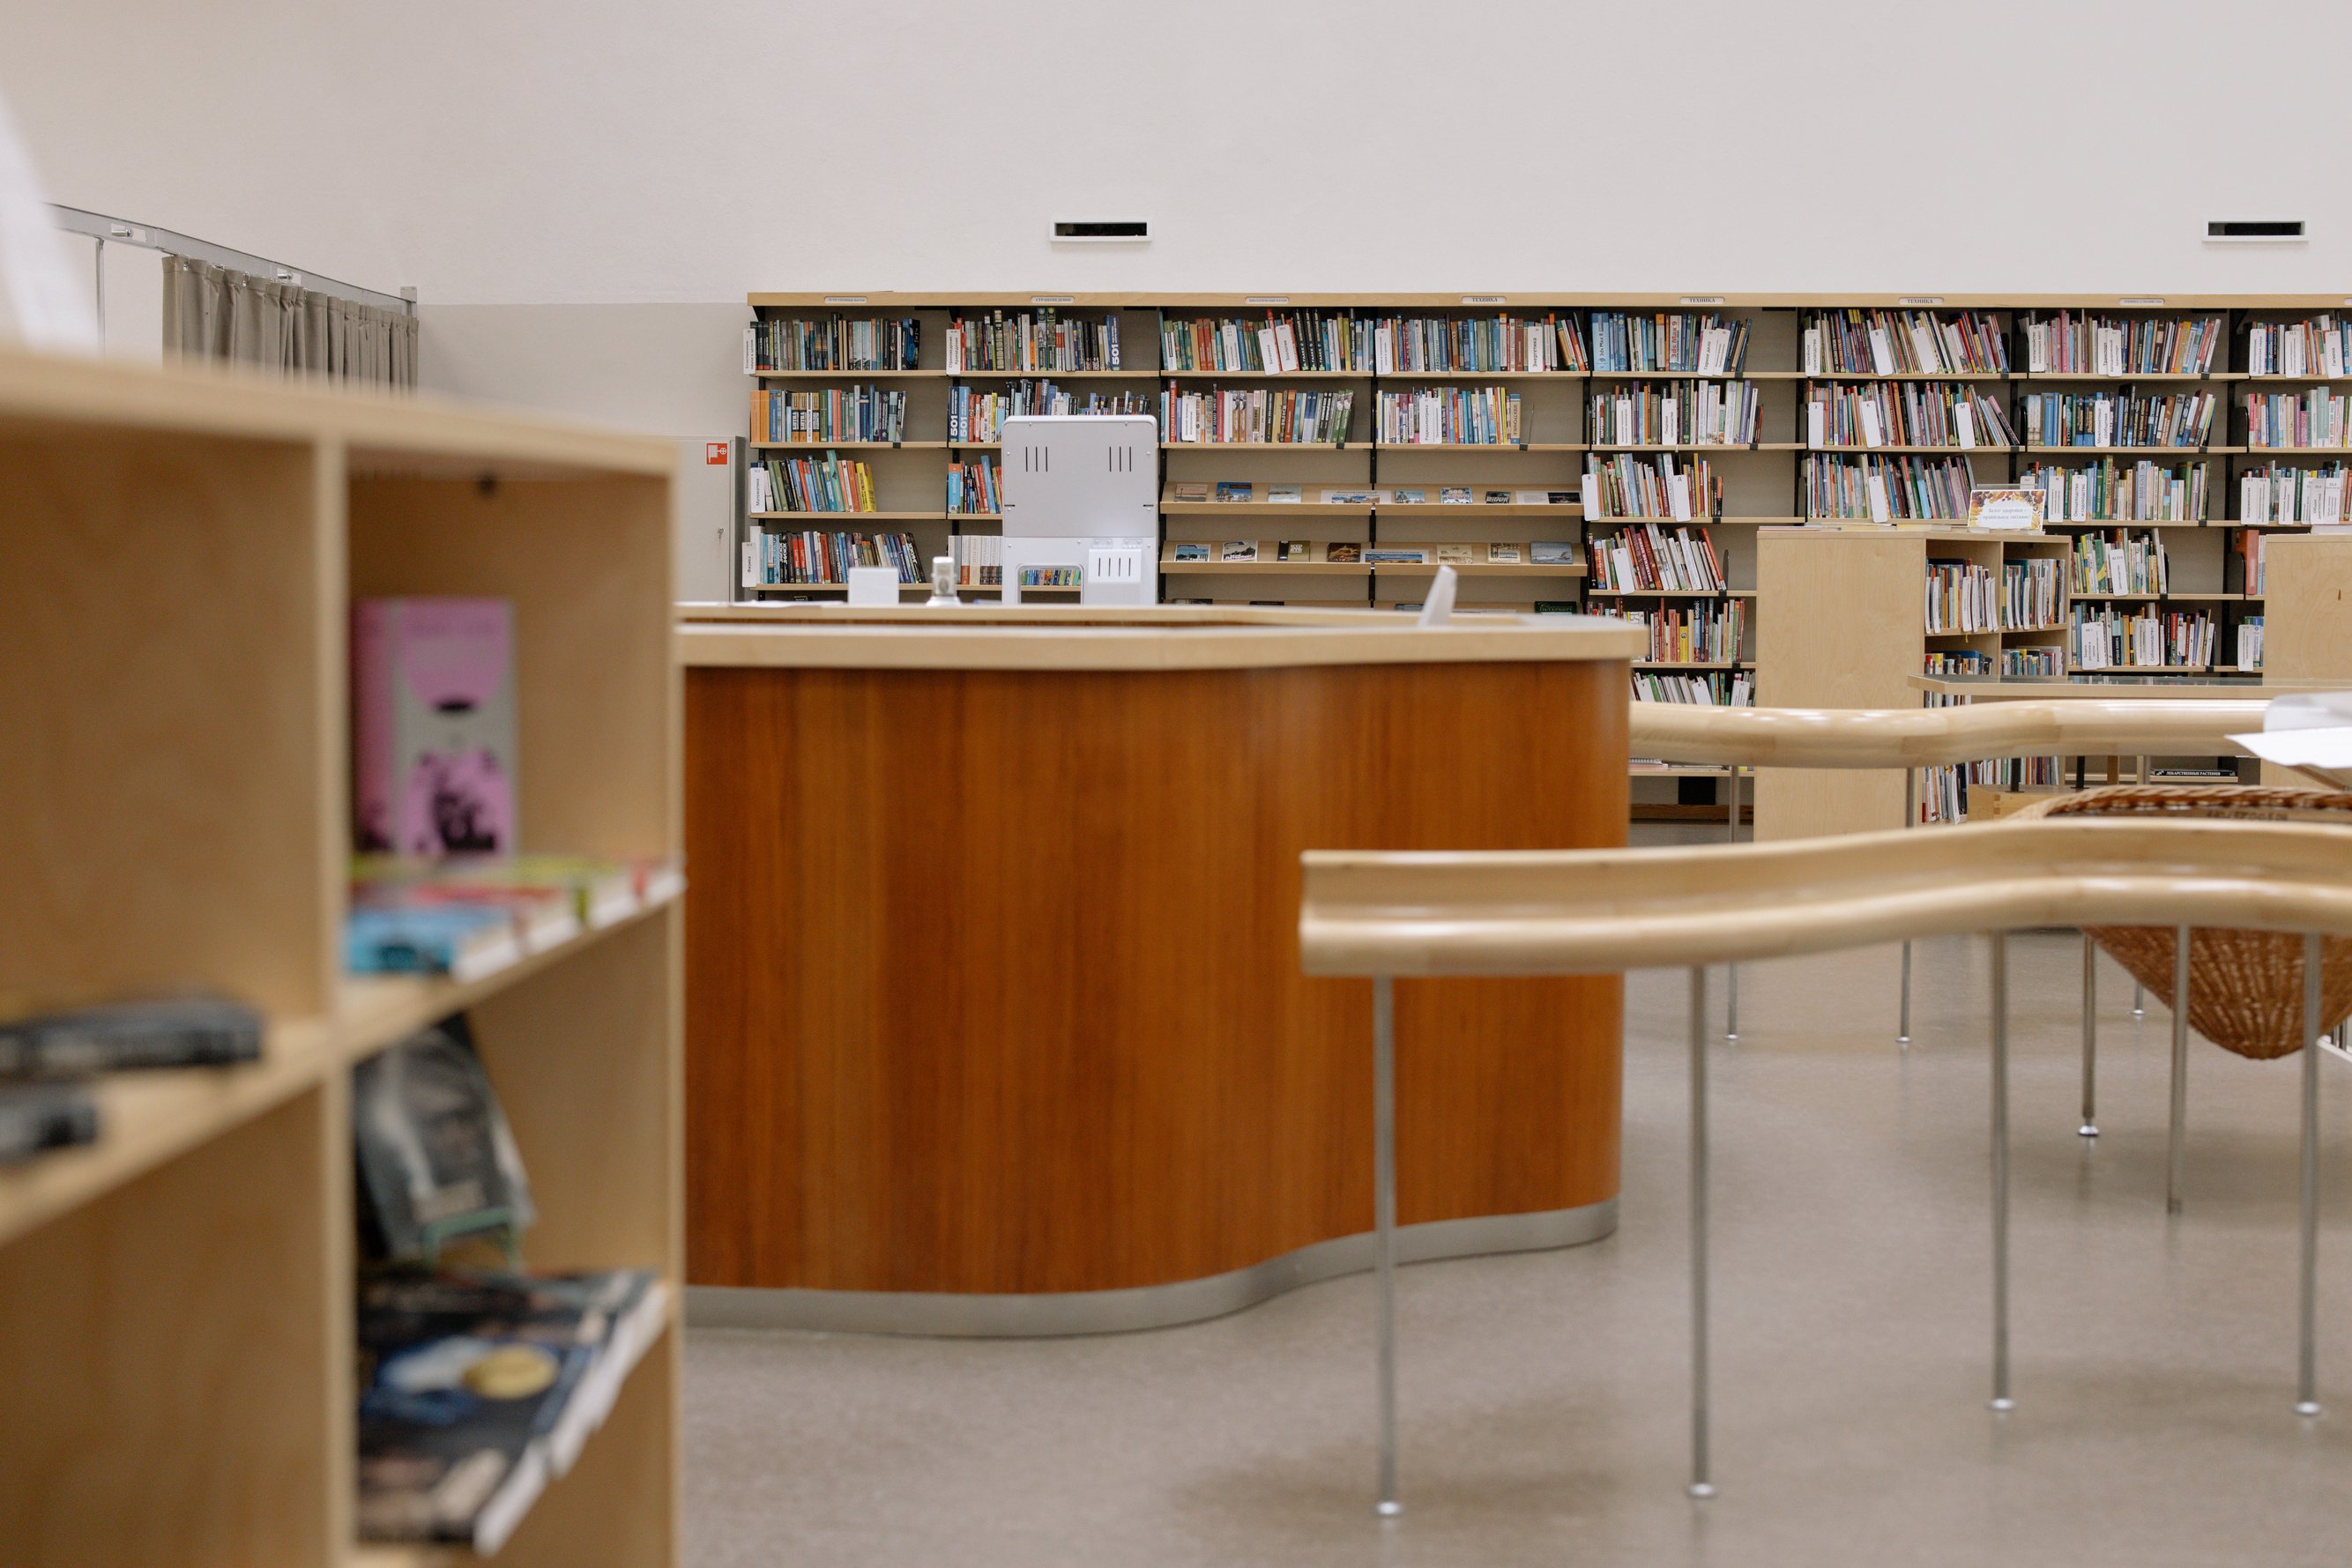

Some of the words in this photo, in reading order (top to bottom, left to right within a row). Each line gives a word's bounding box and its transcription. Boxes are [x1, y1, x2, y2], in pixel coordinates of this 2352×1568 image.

[1111, 344, 1120, 365] 501
[908, 542, 918, 564] ХОКИНГ
[1641, 554, 1652, 583] КИТАЙСКАЯ
